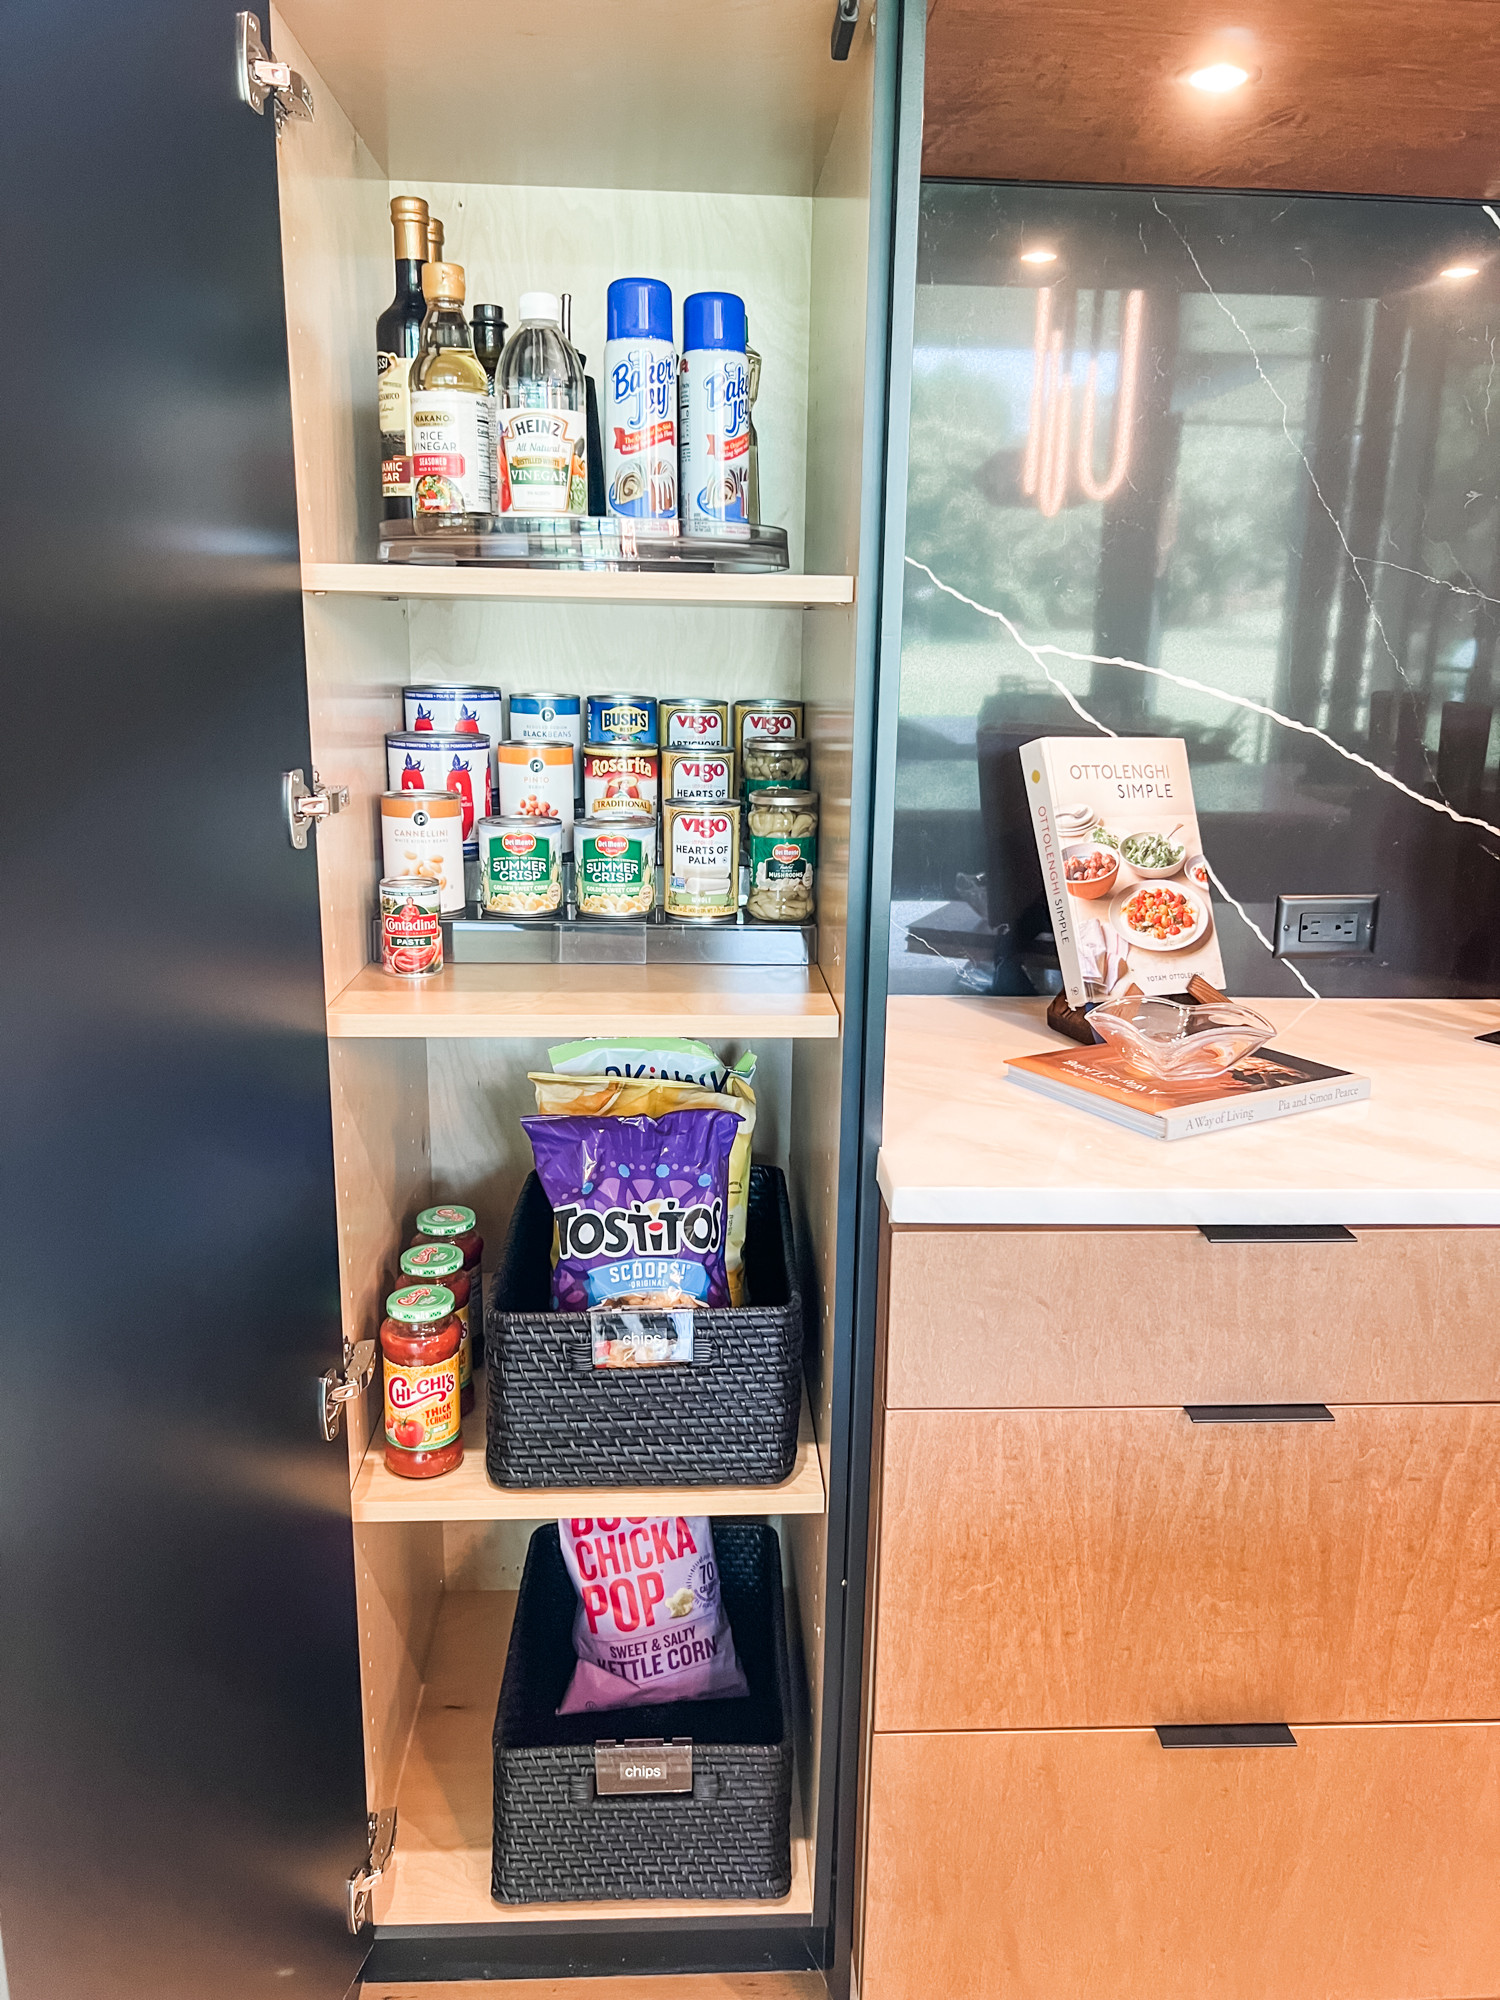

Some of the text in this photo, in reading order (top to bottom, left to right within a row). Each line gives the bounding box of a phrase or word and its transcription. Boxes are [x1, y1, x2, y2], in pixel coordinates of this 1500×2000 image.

[415, 415, 449, 423] NAKANO
[421, 431, 443, 441] RICE
[515, 419, 561, 437] HEINZ
[414, 442, 459, 452] VINEGAR
[516, 442, 560, 453] All Natural
[419, 457, 448, 467] SEASONED
[517, 457, 542, 466] DISTILLED
[511, 469, 568, 483] VINEGAR
[604, 712, 646, 728] BUSH'S
[591, 756, 652, 778] Rosarita
[1069, 764, 1171, 780] OTTOLENGHI
[677, 789, 726, 798] HEARTS OF
[1117, 783, 1174, 799] SIMPLE
[597, 800, 647, 809] TRADITIONAL
[394, 829, 448, 838] CANNELLINI
[676, 845, 729, 855] HEARTS OF
[493, 860, 546, 873] SUMMER
[586, 861, 639, 875] SUMMER
[688, 856, 716, 865] PALM
[499, 870, 542, 881] CRISP
[592, 872, 633, 882] CRISP
[1037, 806, 1070, 945] OTTOLENGHI SIMPLE
[386, 917, 436, 933] Contadina
[396, 938, 426, 946] PASTE
[1146, 974, 1167, 983] YOTAM
[1278, 1085, 1360, 1112] Pia and Simon Pearce
[1185, 1108, 1255, 1131] A Way of Living
[554, 1197, 721, 1253] TOSTITOS
[609, 1261, 686, 1283] SCOOPS!
[622, 1331, 662, 1347] chips
[425, 1402, 452, 1419] THICK
[575, 1516, 698, 1581] CHICKA
[699, 1561, 714, 1584] 70
[582, 1570, 665, 1634] POP
[609, 1625, 697, 1659] SWEET & SALTY
[668, 1635, 718, 1670] CORN
[624, 1764, 662, 1780] chips
